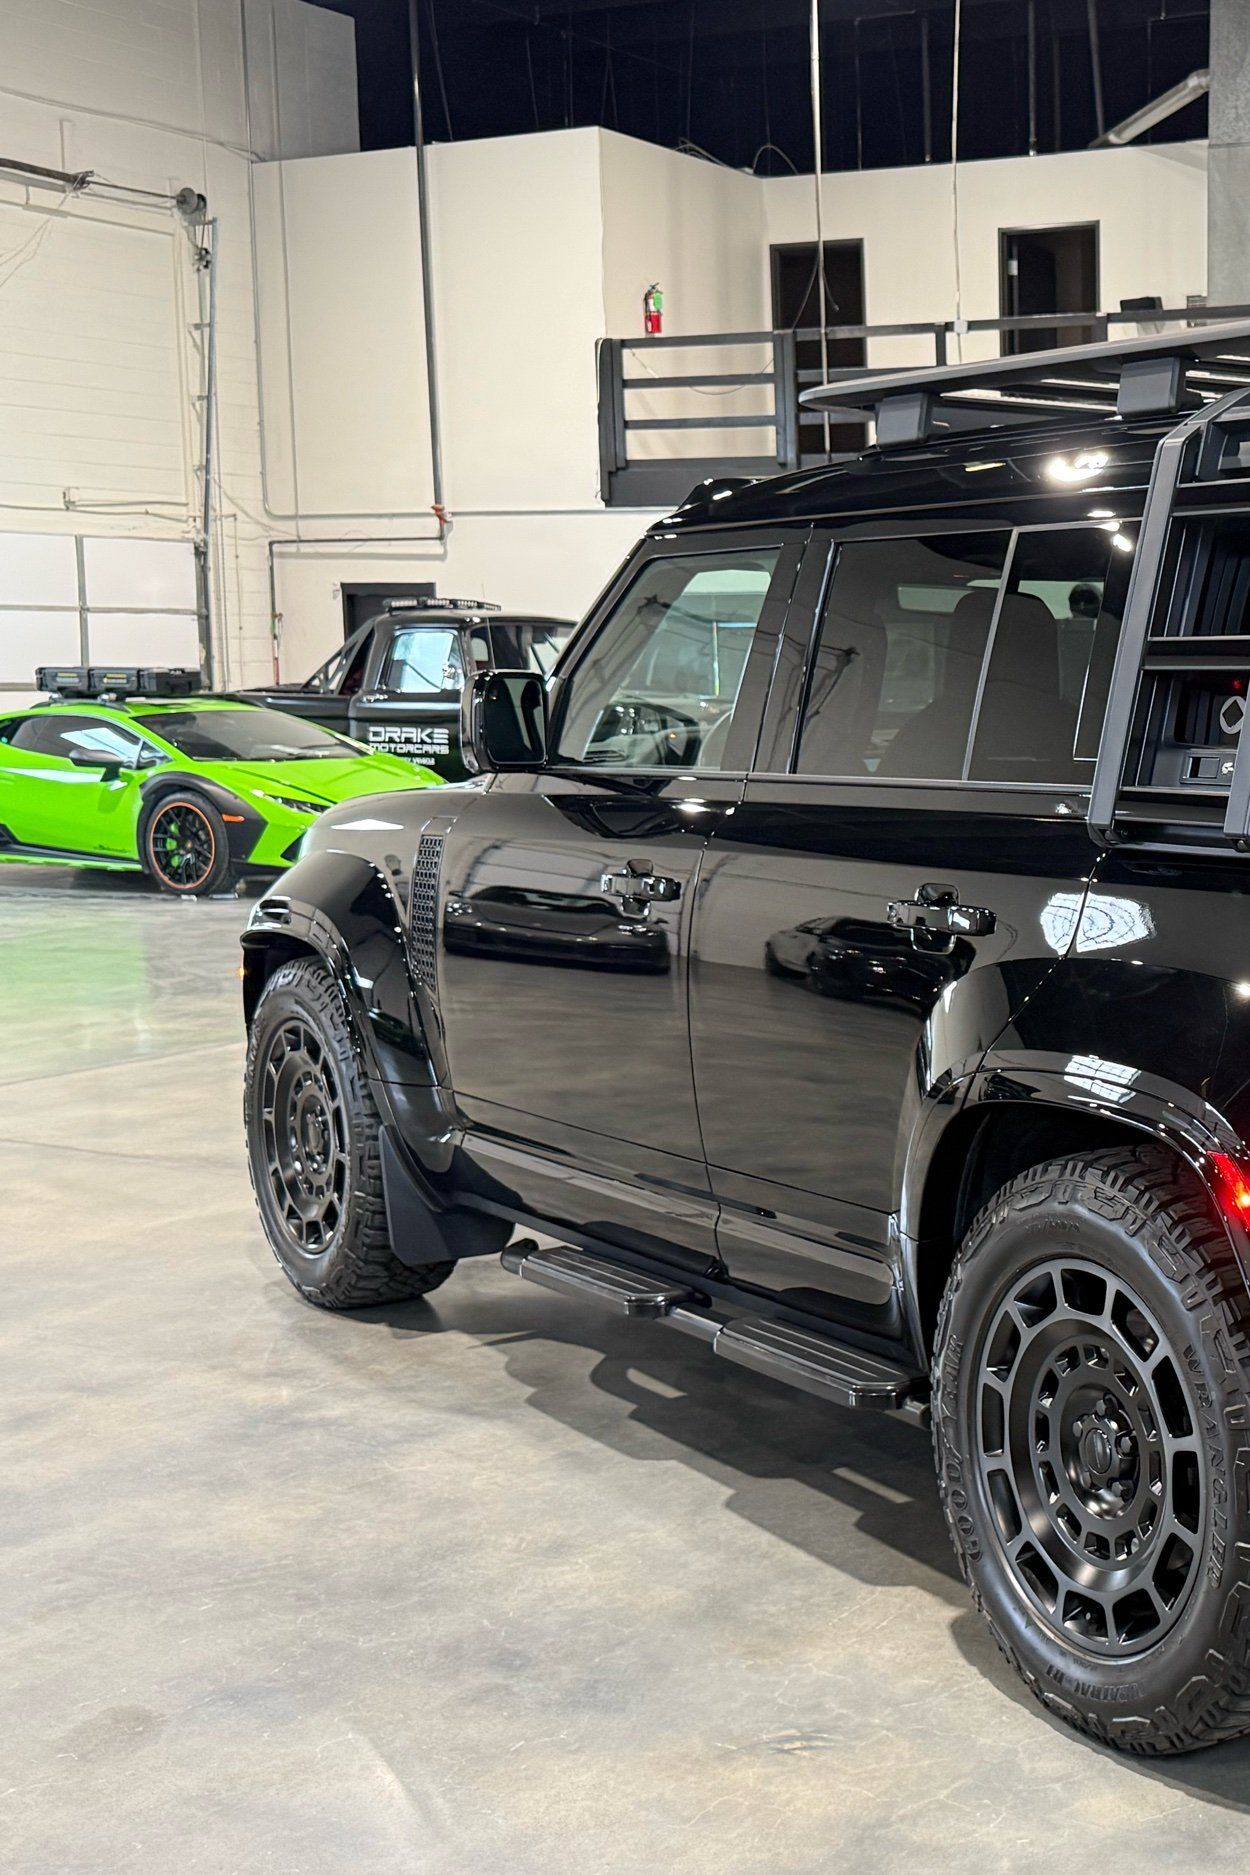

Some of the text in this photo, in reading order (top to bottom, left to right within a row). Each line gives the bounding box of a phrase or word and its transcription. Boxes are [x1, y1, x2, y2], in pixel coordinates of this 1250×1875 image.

[368, 726, 449, 744] DRAKE
[369, 742, 449, 755] MOTORCARS
[1181, 1341, 1229, 1590] WRANGLER
